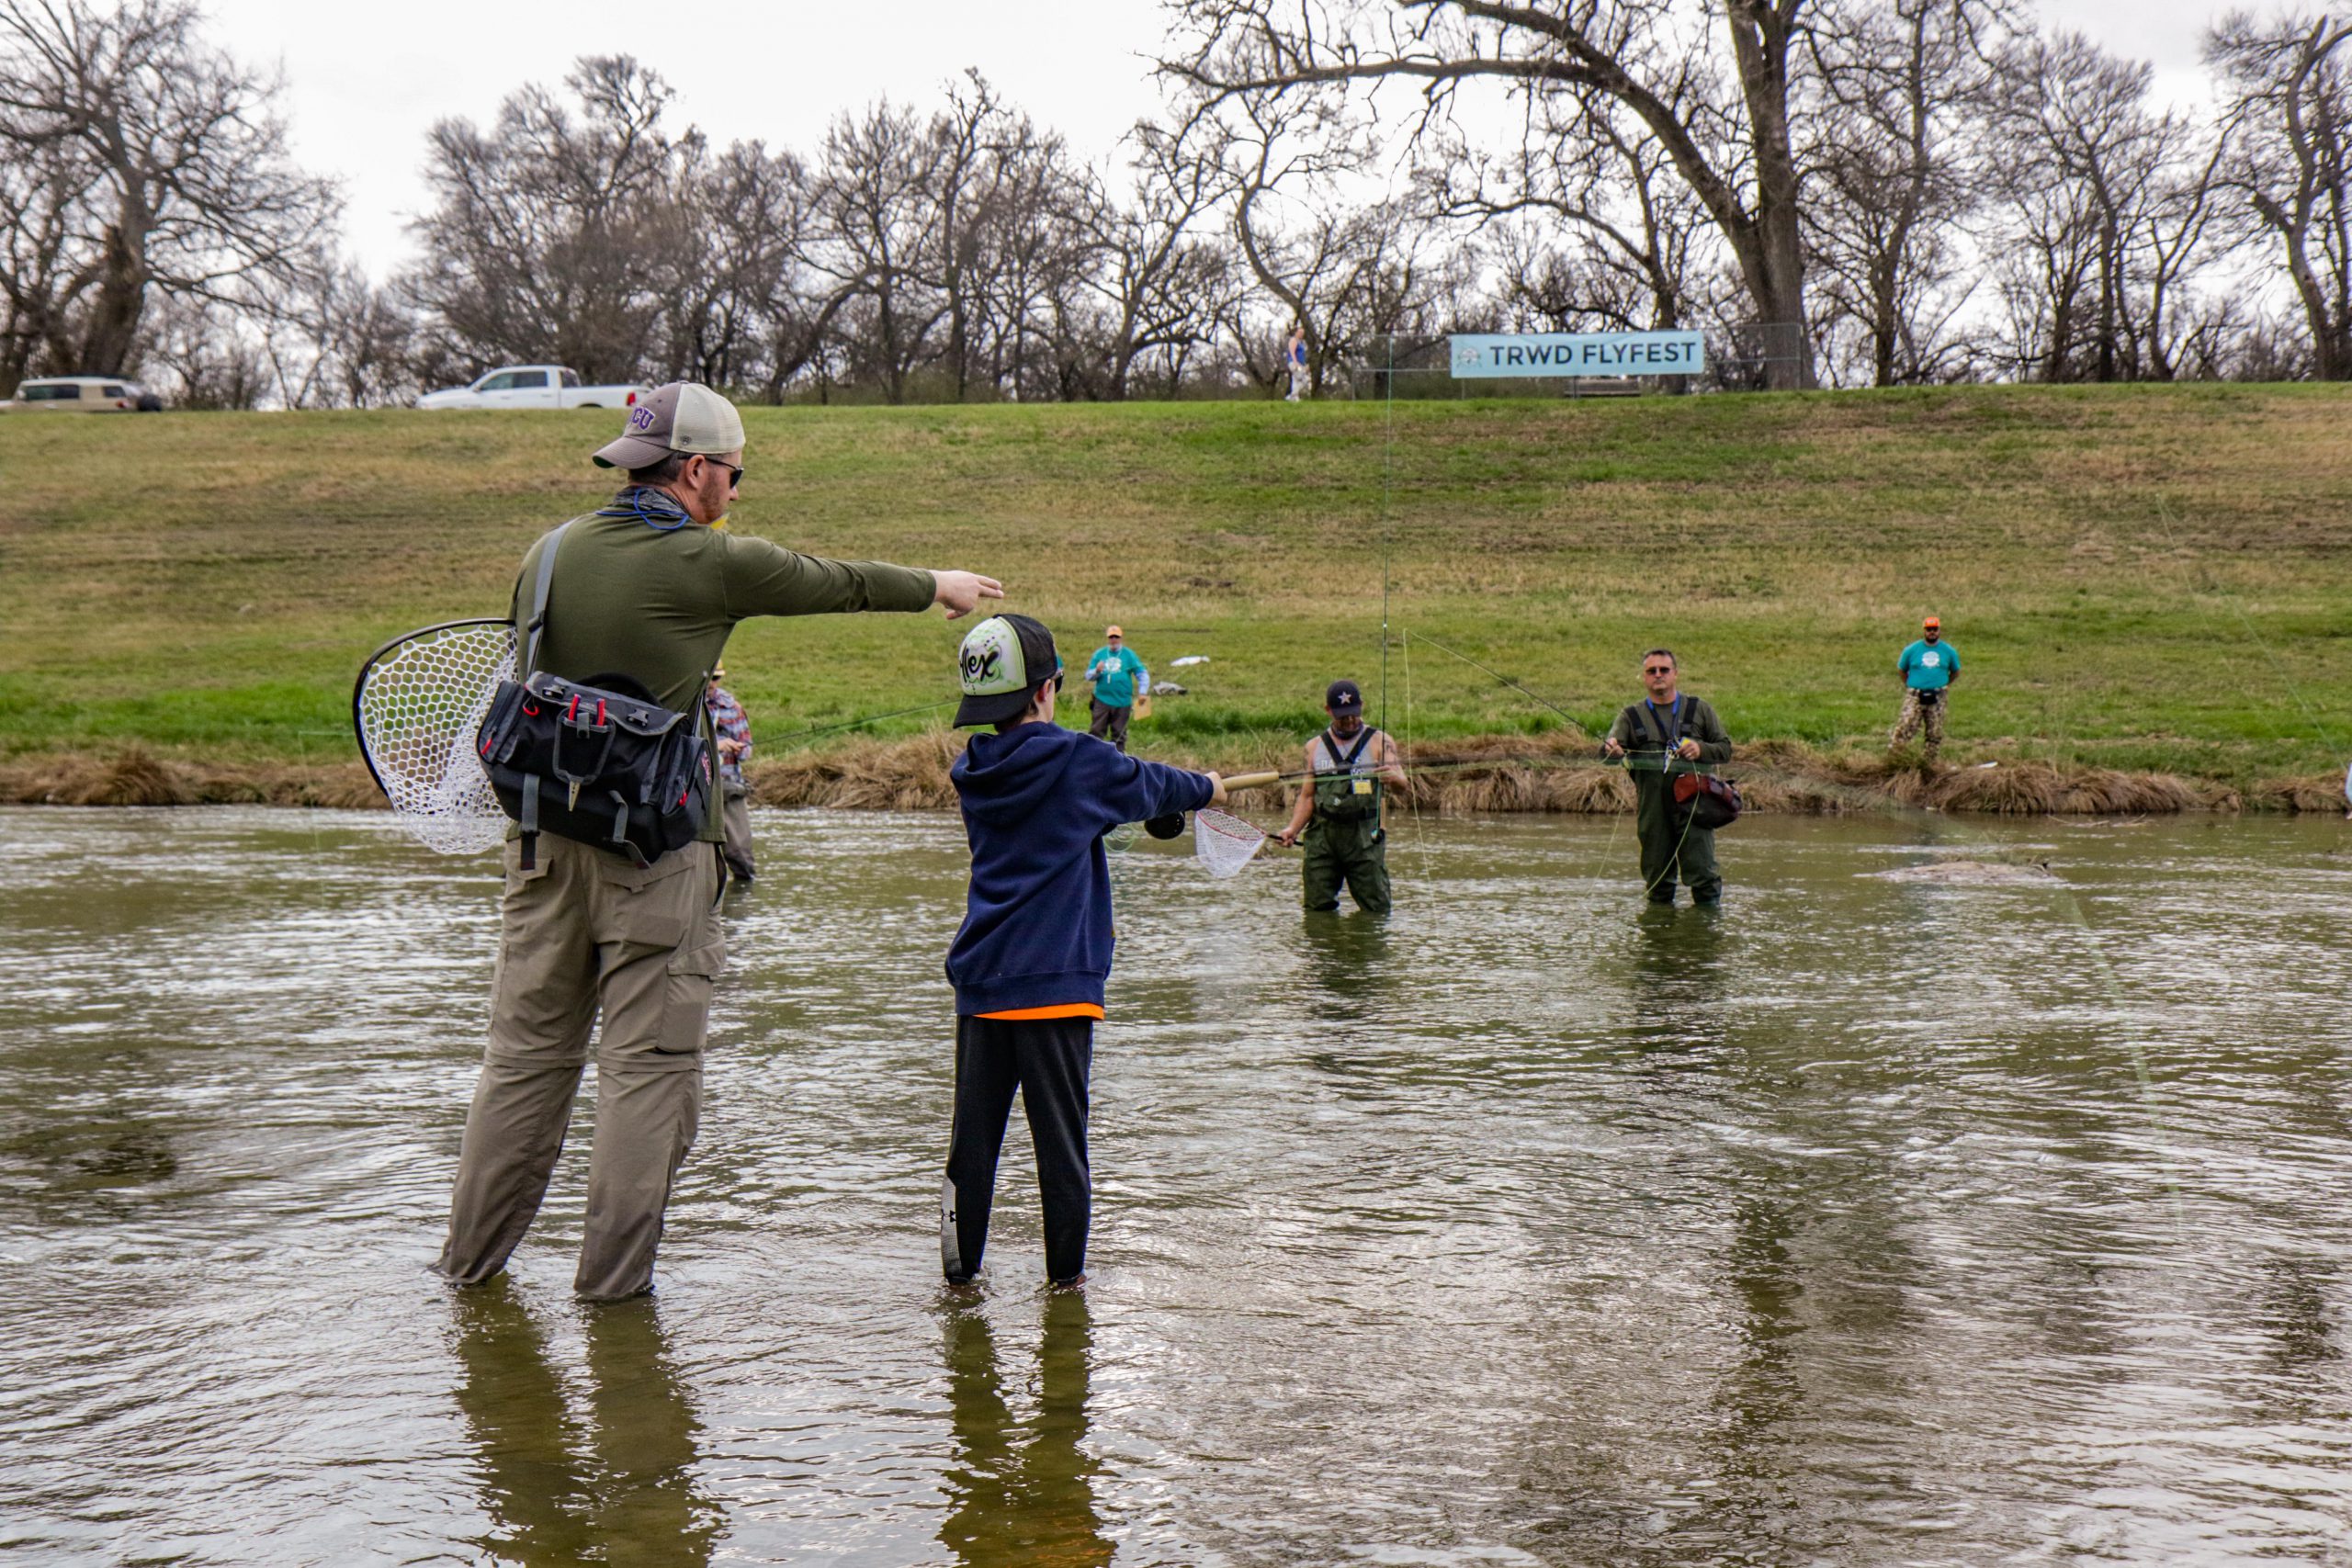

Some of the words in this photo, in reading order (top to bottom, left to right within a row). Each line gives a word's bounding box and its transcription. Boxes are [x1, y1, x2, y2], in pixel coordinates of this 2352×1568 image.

[1489, 344, 1573, 366] TRWD
[1583, 342, 1696, 364] FLYFEST
[630, 406, 656, 430] CU
